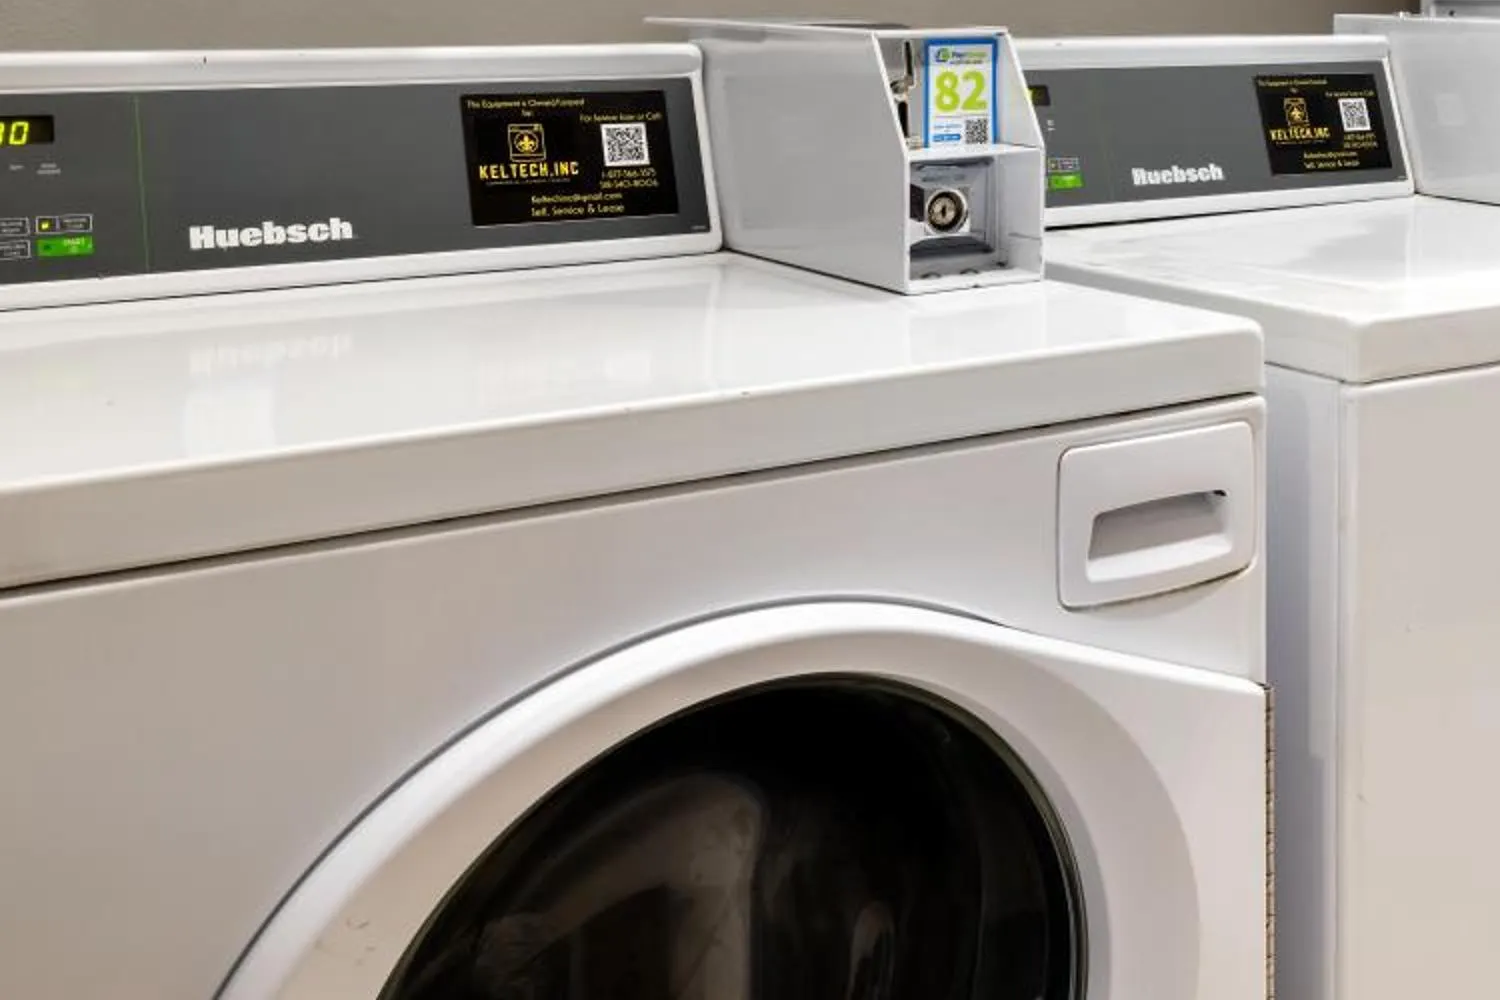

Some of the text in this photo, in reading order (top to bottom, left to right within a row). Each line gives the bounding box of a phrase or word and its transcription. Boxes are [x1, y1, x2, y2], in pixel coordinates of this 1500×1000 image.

[936, 71, 987, 112] 82
[1132, 163, 1225, 186] Huebsch
[189, 217, 353, 250] Huebsch
